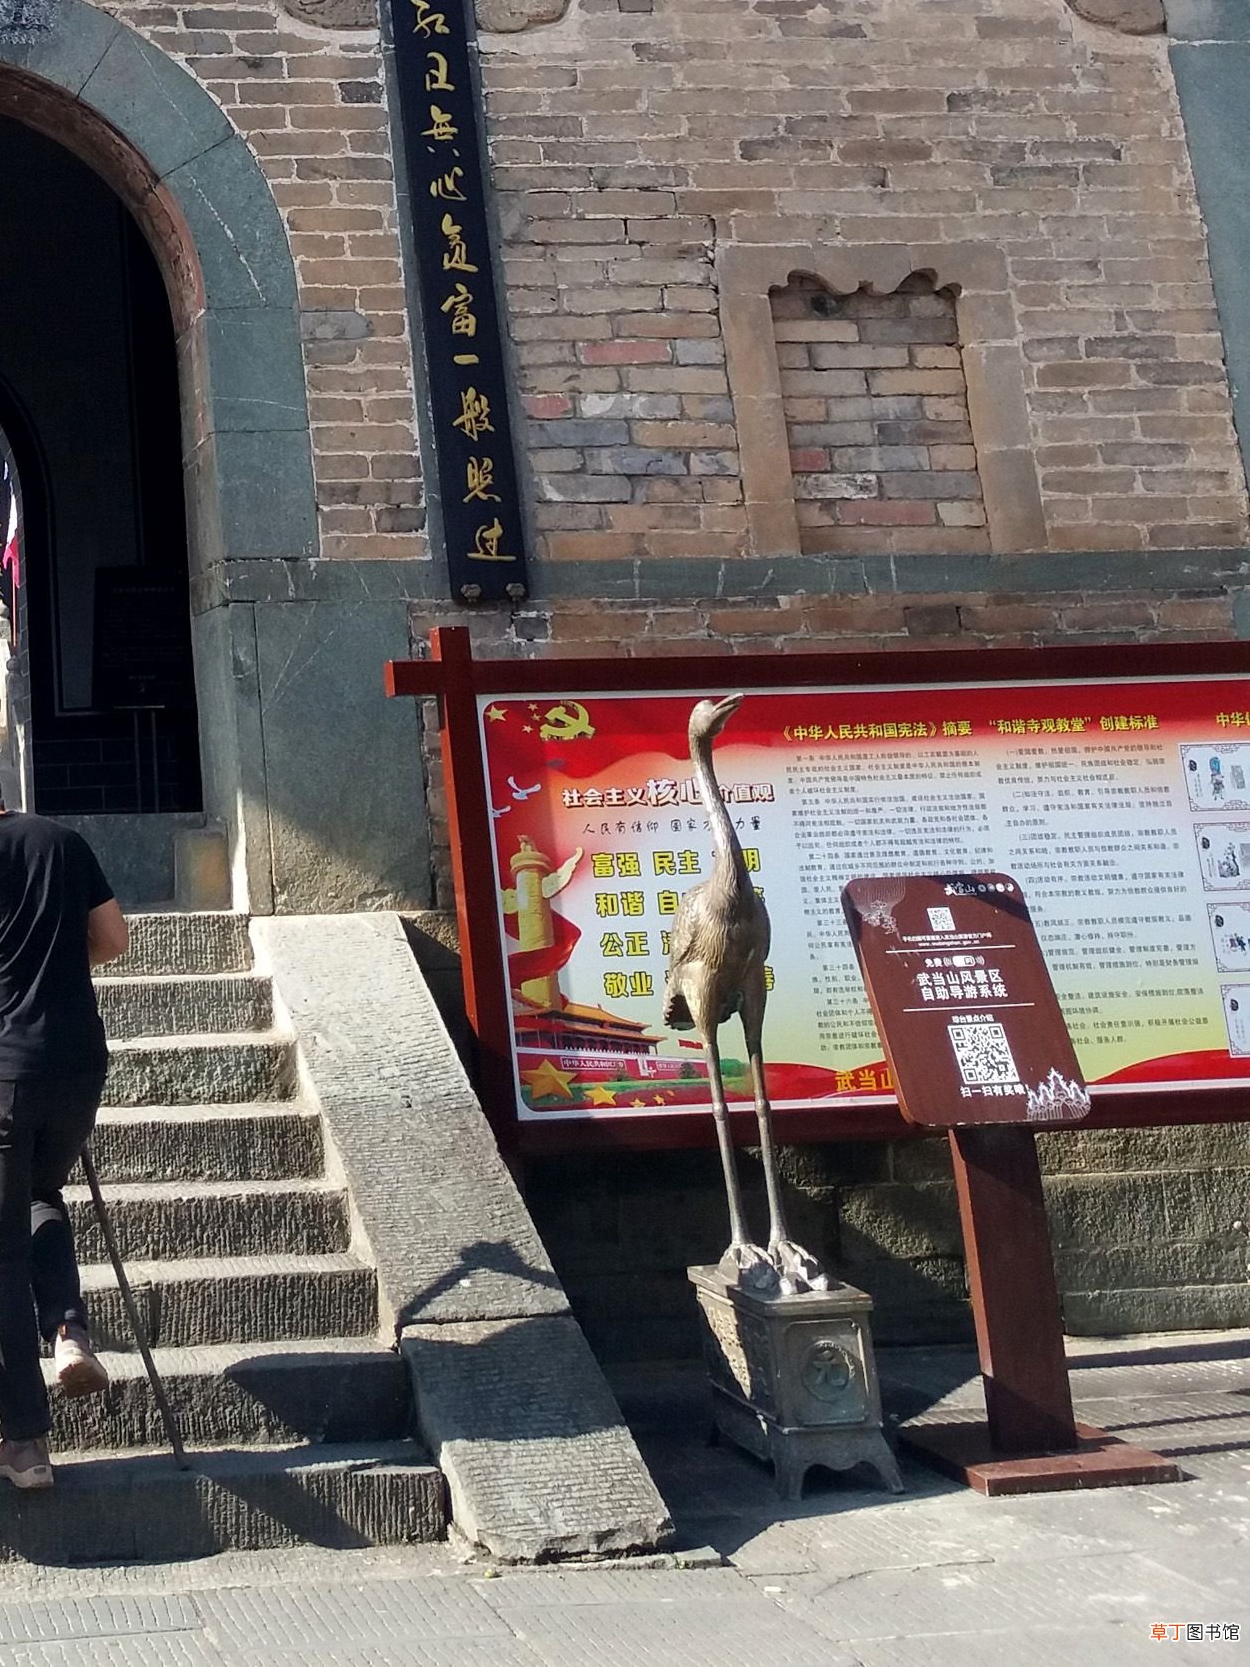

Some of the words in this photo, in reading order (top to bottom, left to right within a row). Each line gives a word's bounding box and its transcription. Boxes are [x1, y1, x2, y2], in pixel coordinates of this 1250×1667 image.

[1215, 710, 1250, 729] 中华
[782, 720, 973, 742] 《中华人民共和国宪法》摘要
[582, 820, 659, 835] 人民有信仰
[670, 815, 762, 832] 国家才力量
[592, 852, 641, 877] 富强
[653, 850, 701, 875] 民主
[596, 892, 644, 917] 和谐
[600, 931, 650, 957] 公正
[924, 957, 943, 968] 免费
[604, 972, 654, 998] 敬业
[916, 968, 1004, 987] 武当山风景区
[921, 983, 1009, 1001] 自助导游系统
